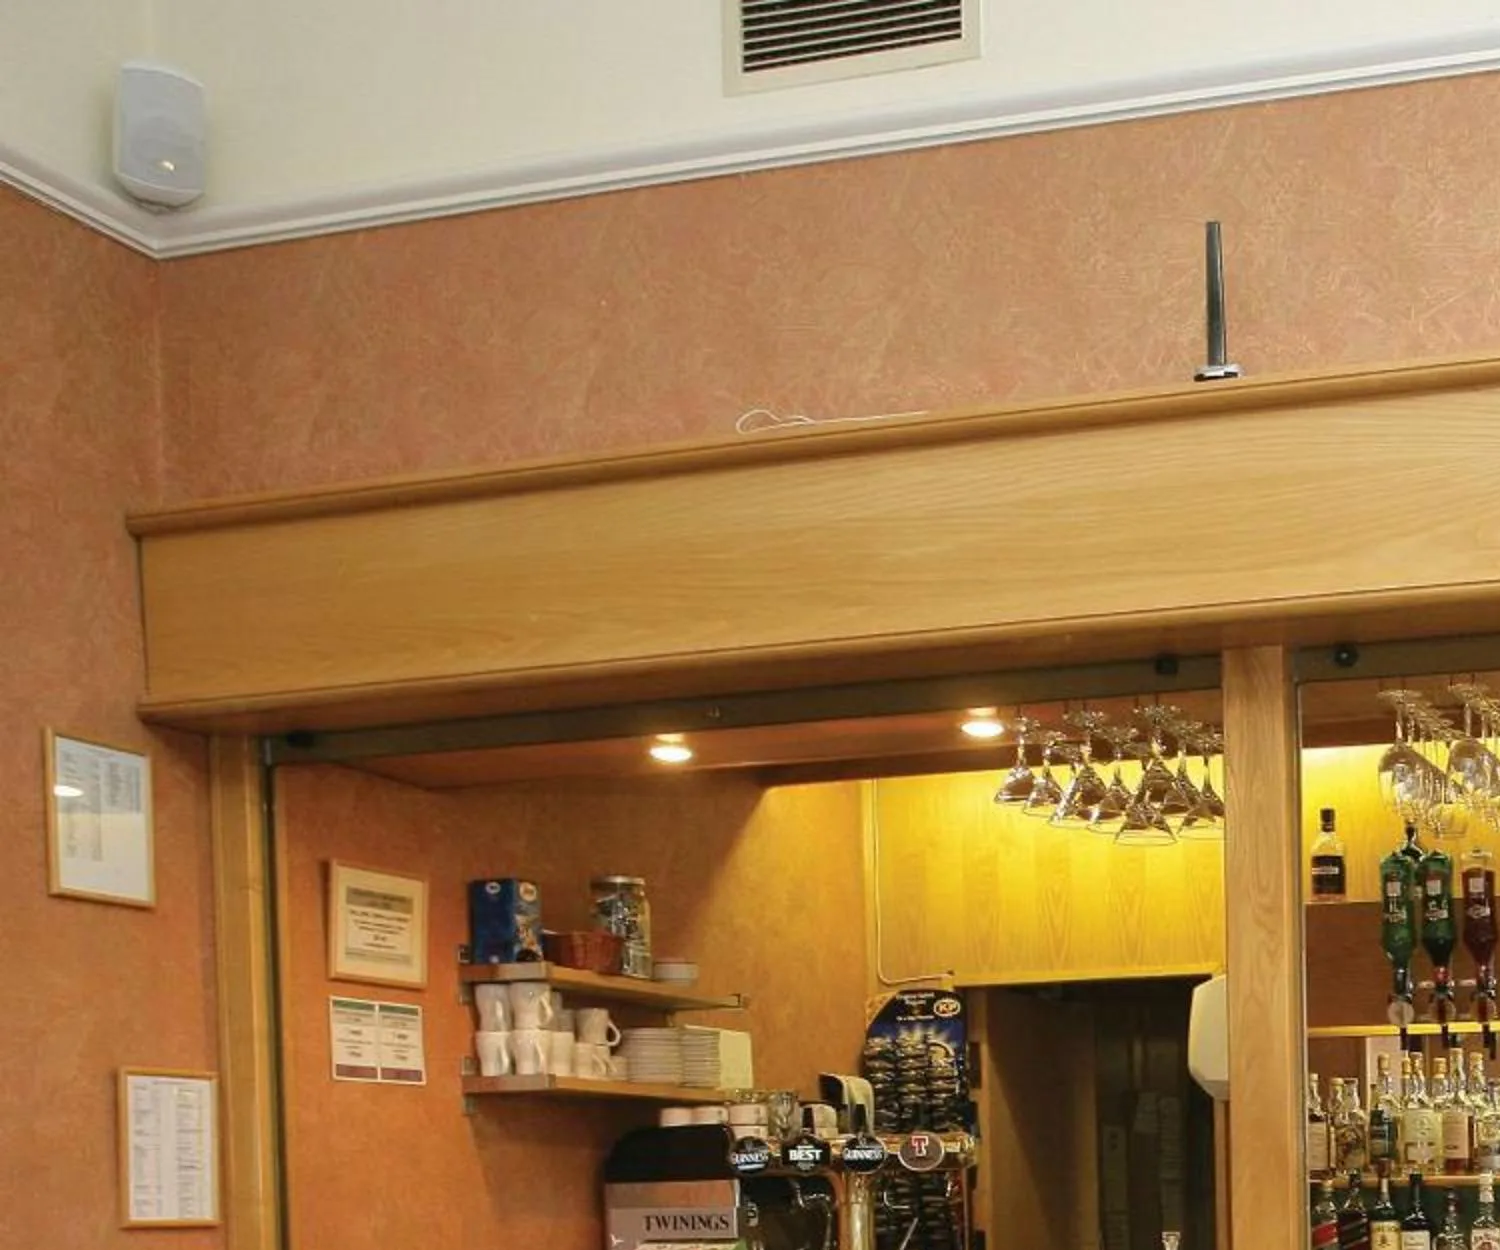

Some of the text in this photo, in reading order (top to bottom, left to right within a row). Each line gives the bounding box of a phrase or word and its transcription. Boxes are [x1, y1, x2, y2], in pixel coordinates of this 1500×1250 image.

[911, 1134, 929, 1157] T
[788, 1149, 822, 1161] BEST
[643, 1214, 730, 1232] TWININGS
